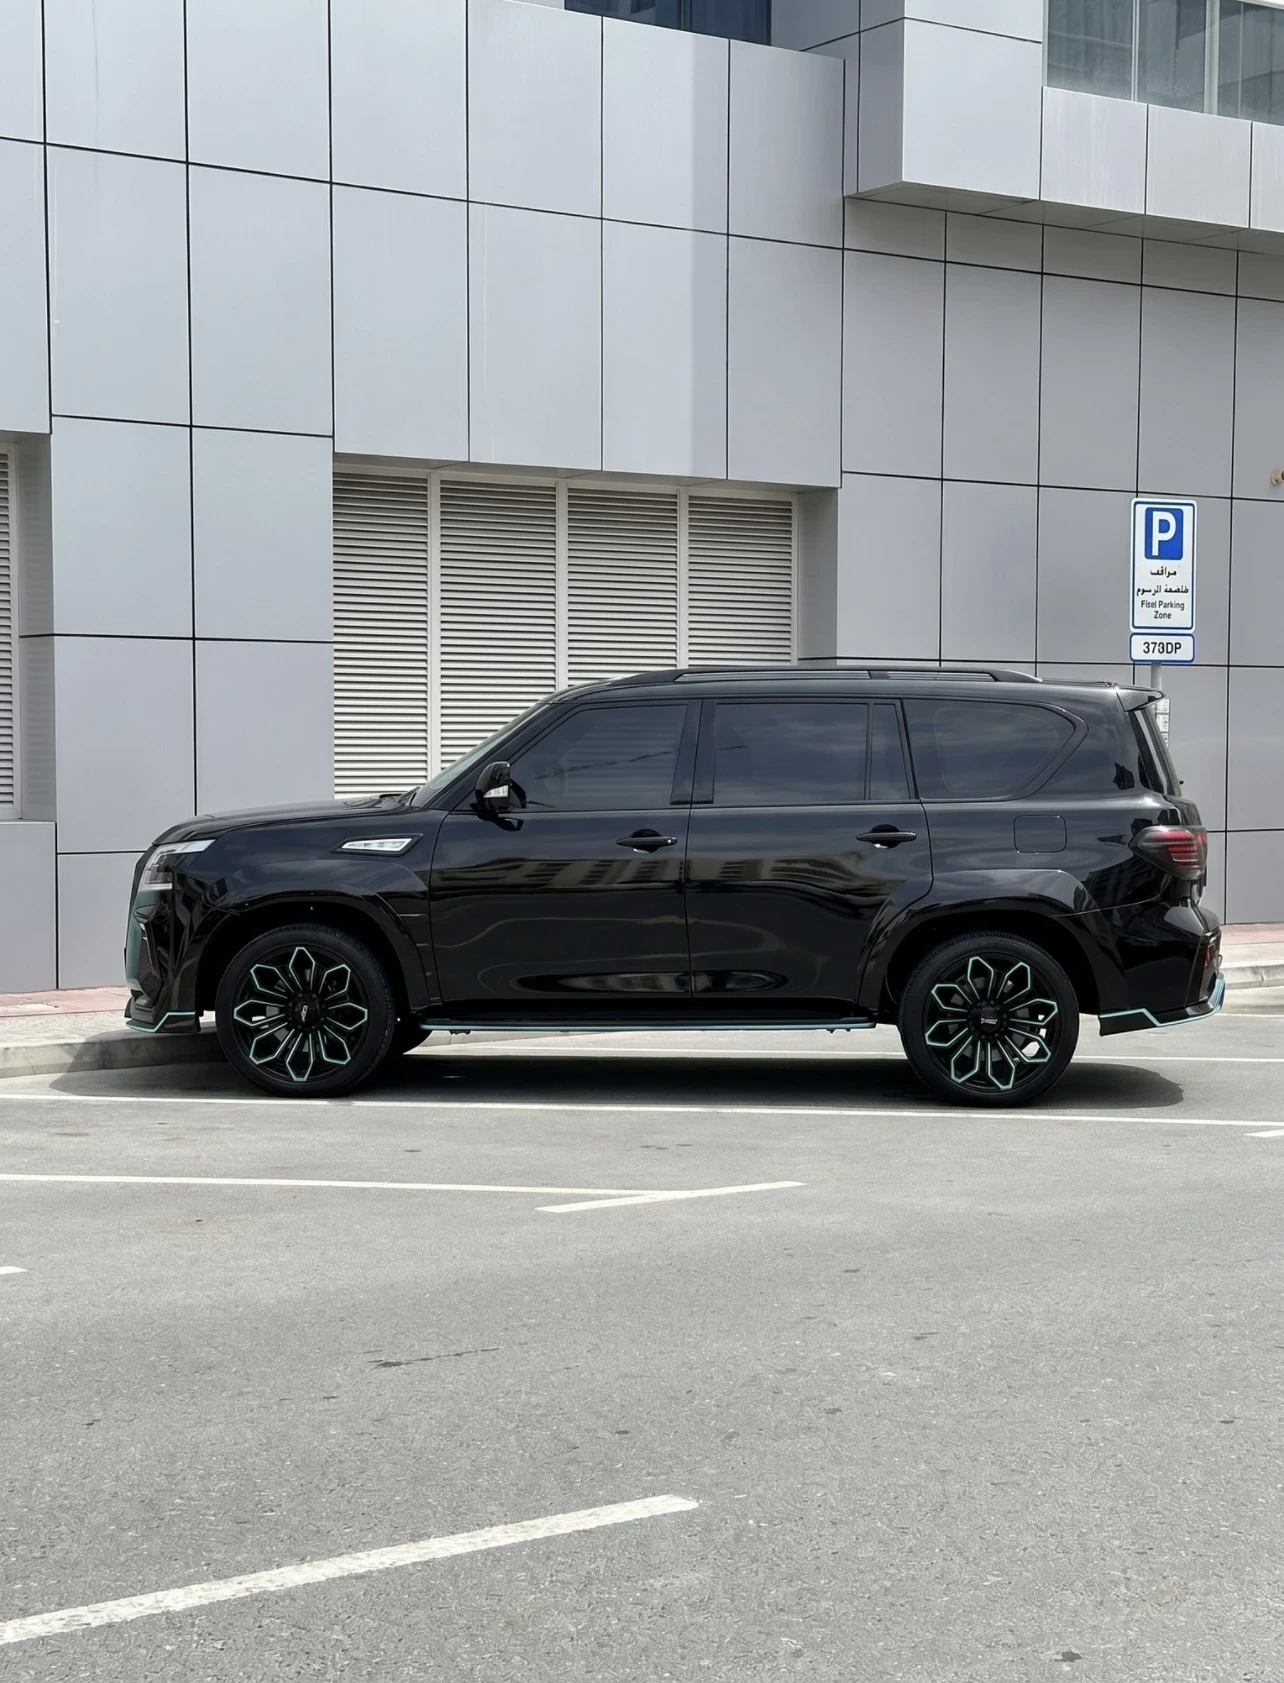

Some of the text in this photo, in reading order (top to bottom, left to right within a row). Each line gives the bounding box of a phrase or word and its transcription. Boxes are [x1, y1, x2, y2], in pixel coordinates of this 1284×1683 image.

[1152, 511, 1177, 556] P
[1158, 600, 1185, 611] Parking
[1153, 610, 1172, 619] Zone
[1143, 641, 1182, 654] 373DP
